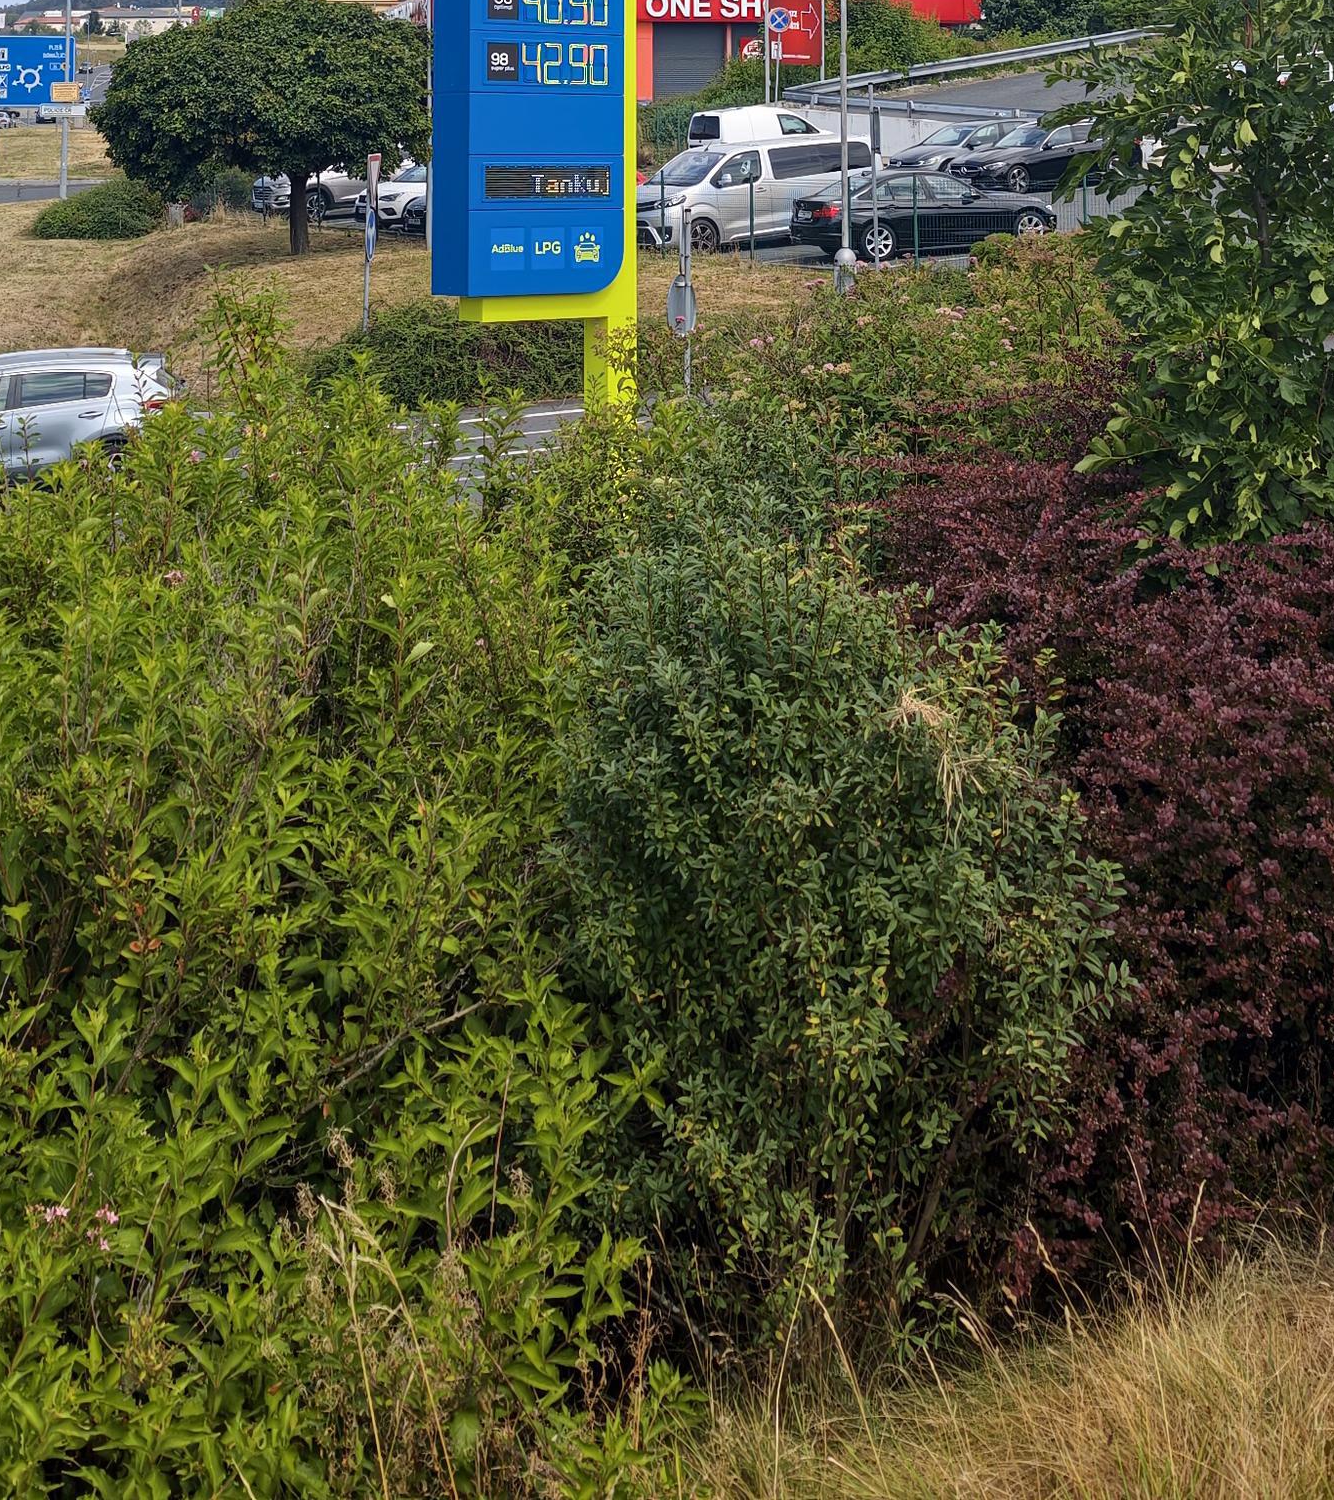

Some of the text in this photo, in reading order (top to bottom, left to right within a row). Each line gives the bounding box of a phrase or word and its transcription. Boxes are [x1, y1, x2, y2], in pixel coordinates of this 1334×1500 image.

[490, 52, 509, 65] 98
[491, 243, 524, 254] AdBlue
[535, 241, 562, 255] LPG
